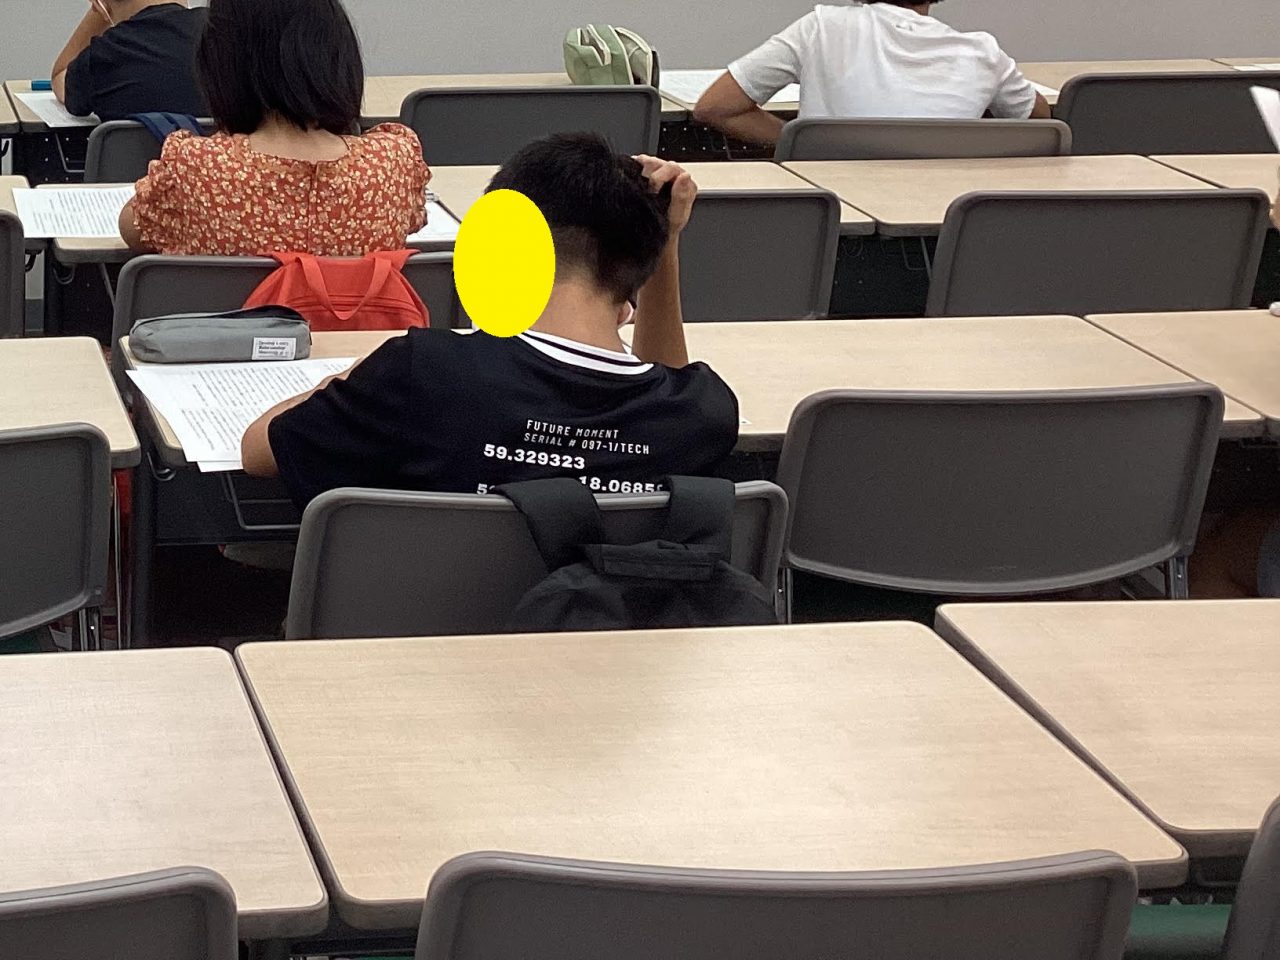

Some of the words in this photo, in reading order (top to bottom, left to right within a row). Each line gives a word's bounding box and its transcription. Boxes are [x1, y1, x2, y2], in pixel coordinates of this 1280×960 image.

[526, 419, 572, 437] FUTURE
[575, 428, 620, 440] MOMENT
[523, 432, 563, 447] SERIAL
[581, 439, 651, 456] 097-1/TECH
[483, 443, 586, 470] 59.329323
[476, 482, 497, 495] 5
[579, 475, 664, 494] 8.0685
